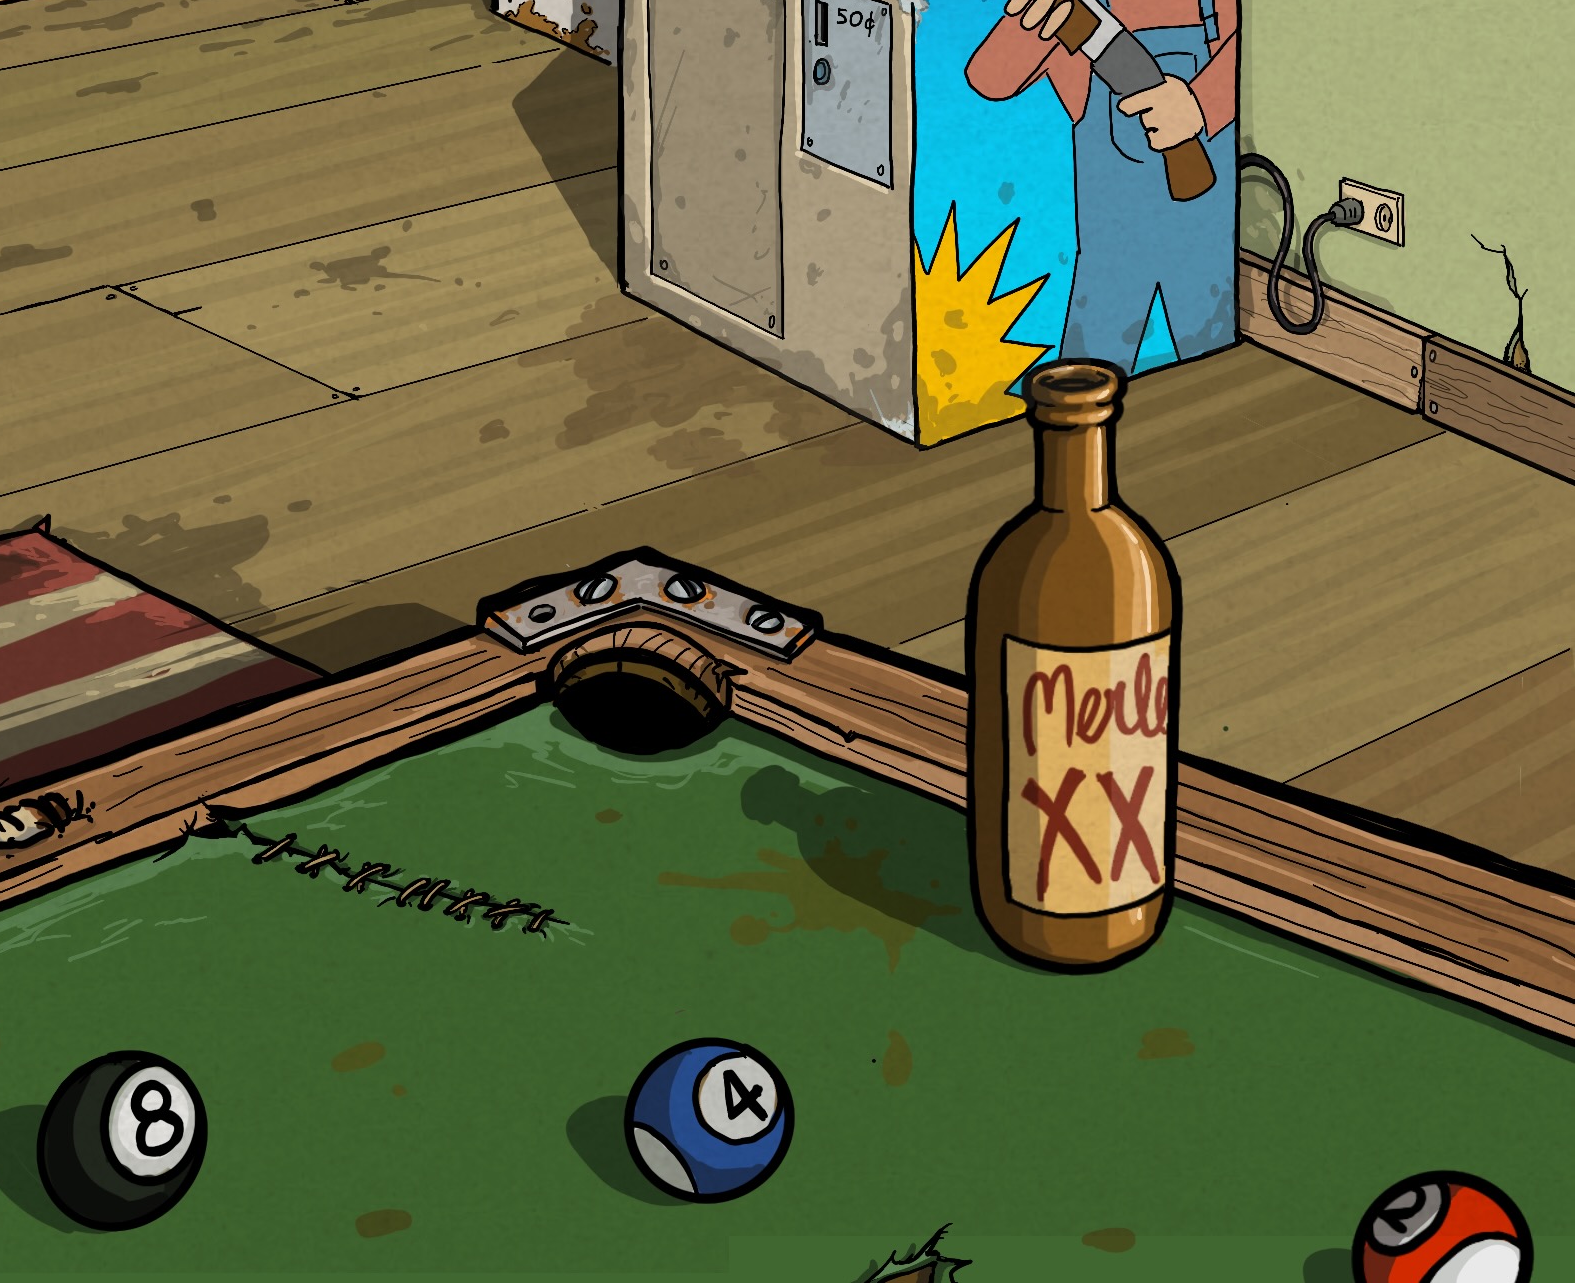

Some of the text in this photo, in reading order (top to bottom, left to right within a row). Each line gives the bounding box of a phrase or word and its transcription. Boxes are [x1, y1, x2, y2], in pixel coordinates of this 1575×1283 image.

[837, 7, 875, 37] 50¢
[1021, 766, 1161, 902] XX
[130, 1079, 185, 1158] 8
[723, 1069, 768, 1122] 4
